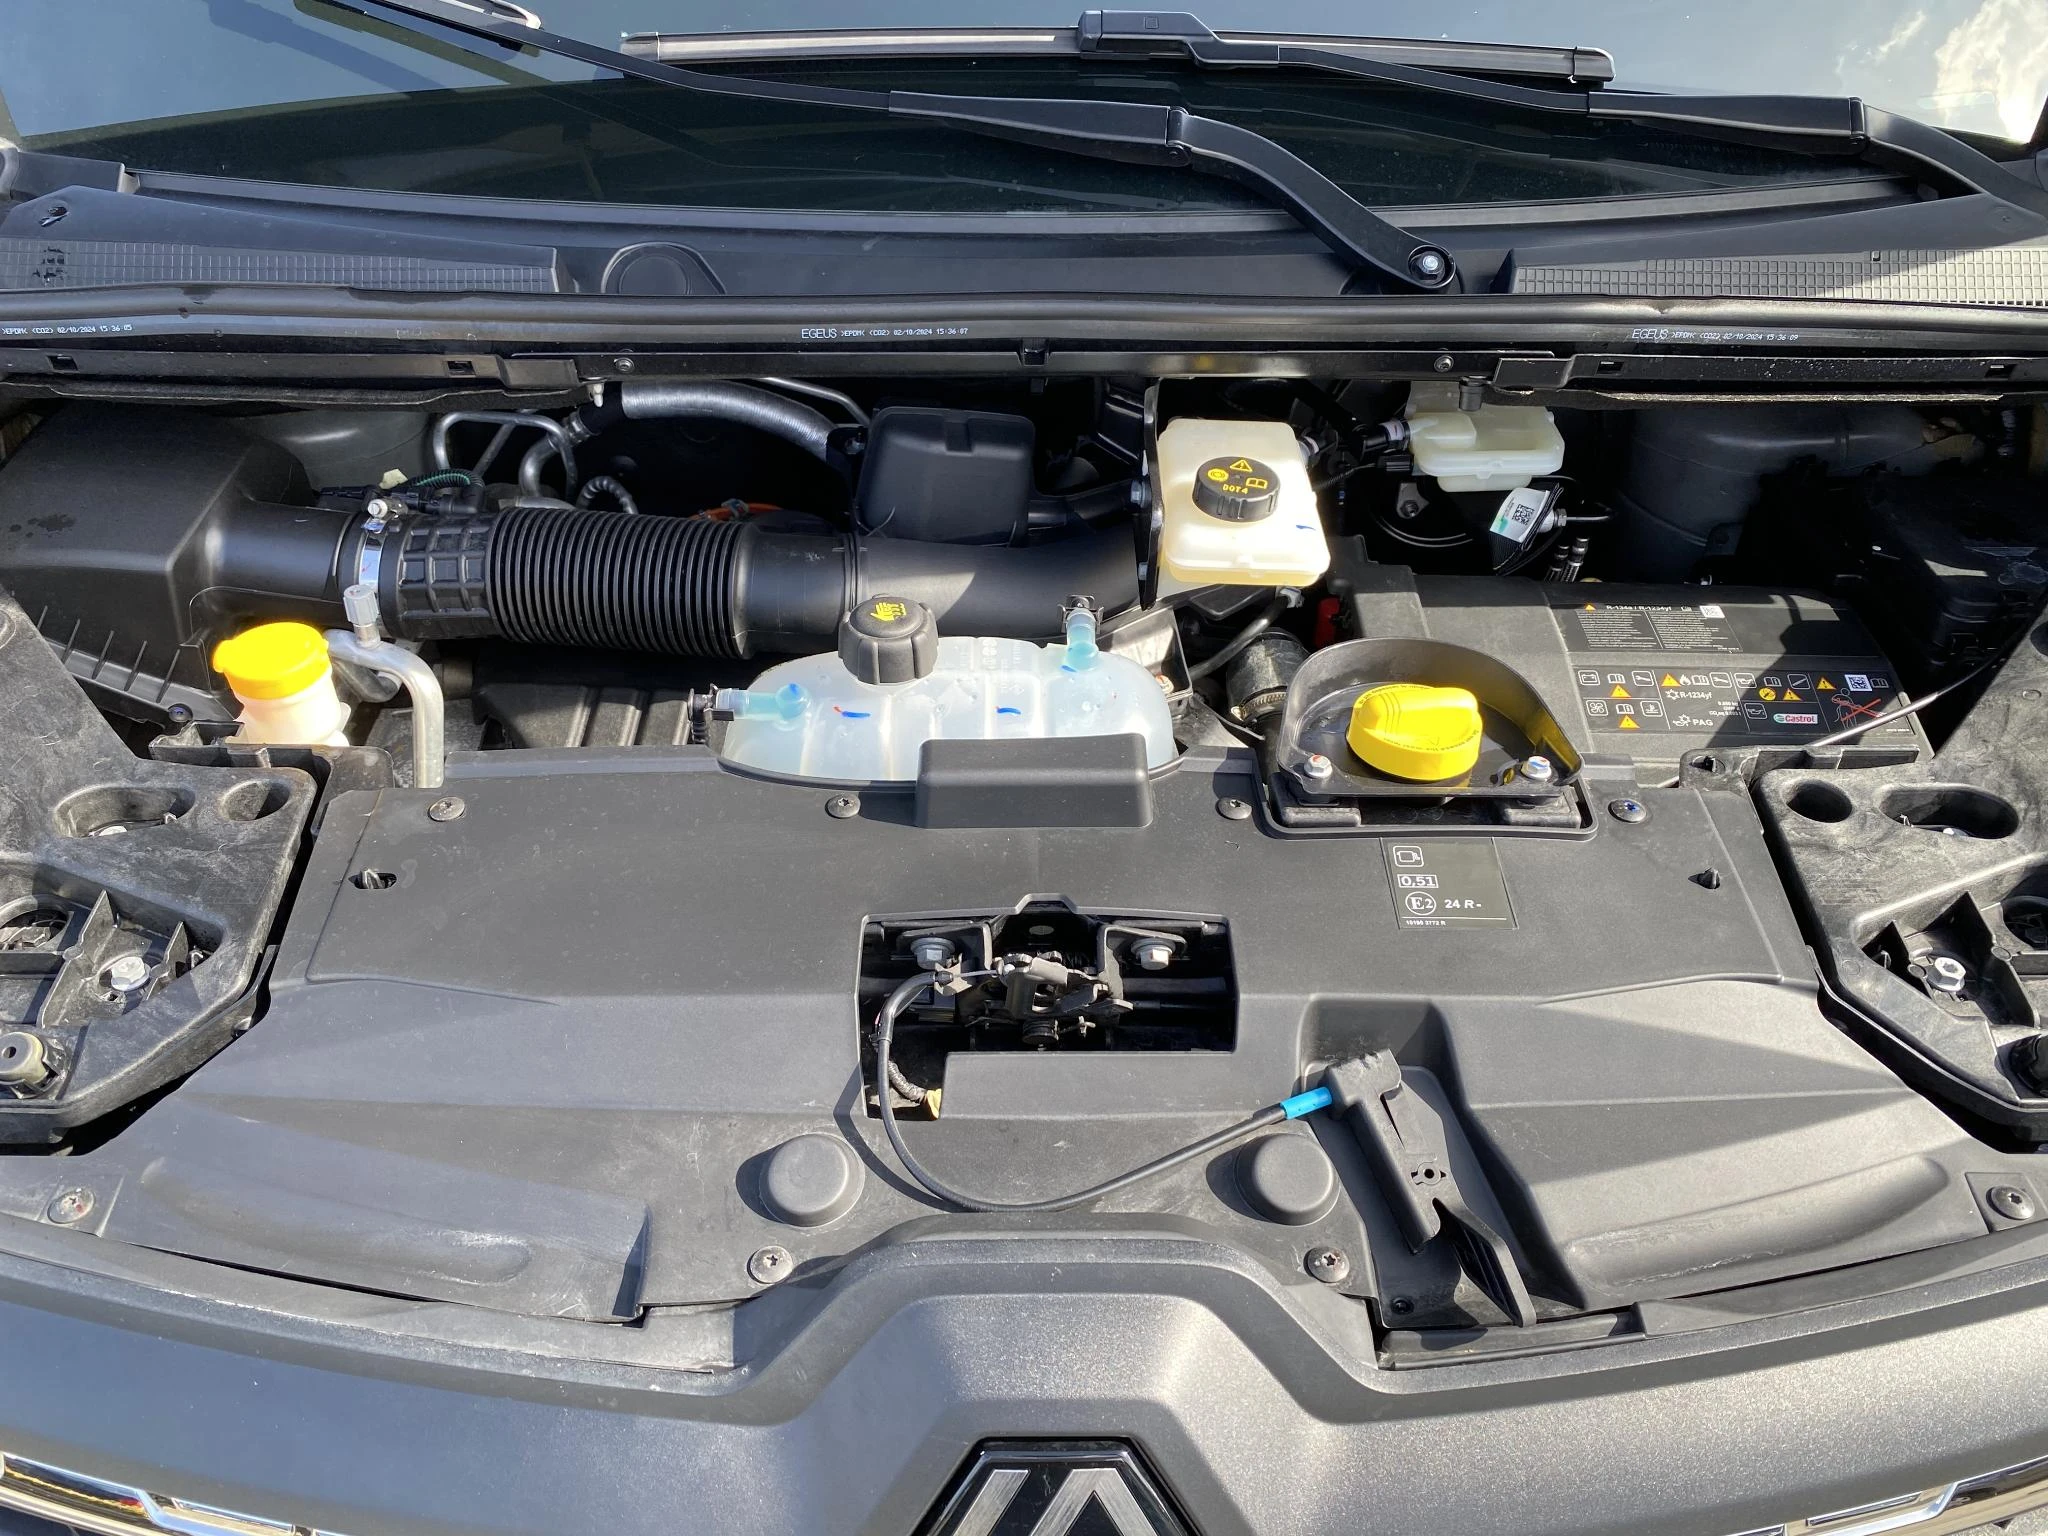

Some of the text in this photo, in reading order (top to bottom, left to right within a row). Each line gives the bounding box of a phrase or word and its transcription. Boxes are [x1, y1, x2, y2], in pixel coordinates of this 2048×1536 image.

[57, 326, 96, 334] 02/10/2024
[801, 328, 838, 339] EGEUS
[893, 328, 933, 336] 02/10/2024
[1631, 328, 1669, 340] EGEUS
[1723, 332, 1763, 340] 02/10/2024
[1680, 691, 1712, 700] R-1234yf
[1785, 714, 1816, 723] Castrol
[1444, 899, 1461, 909] 24
